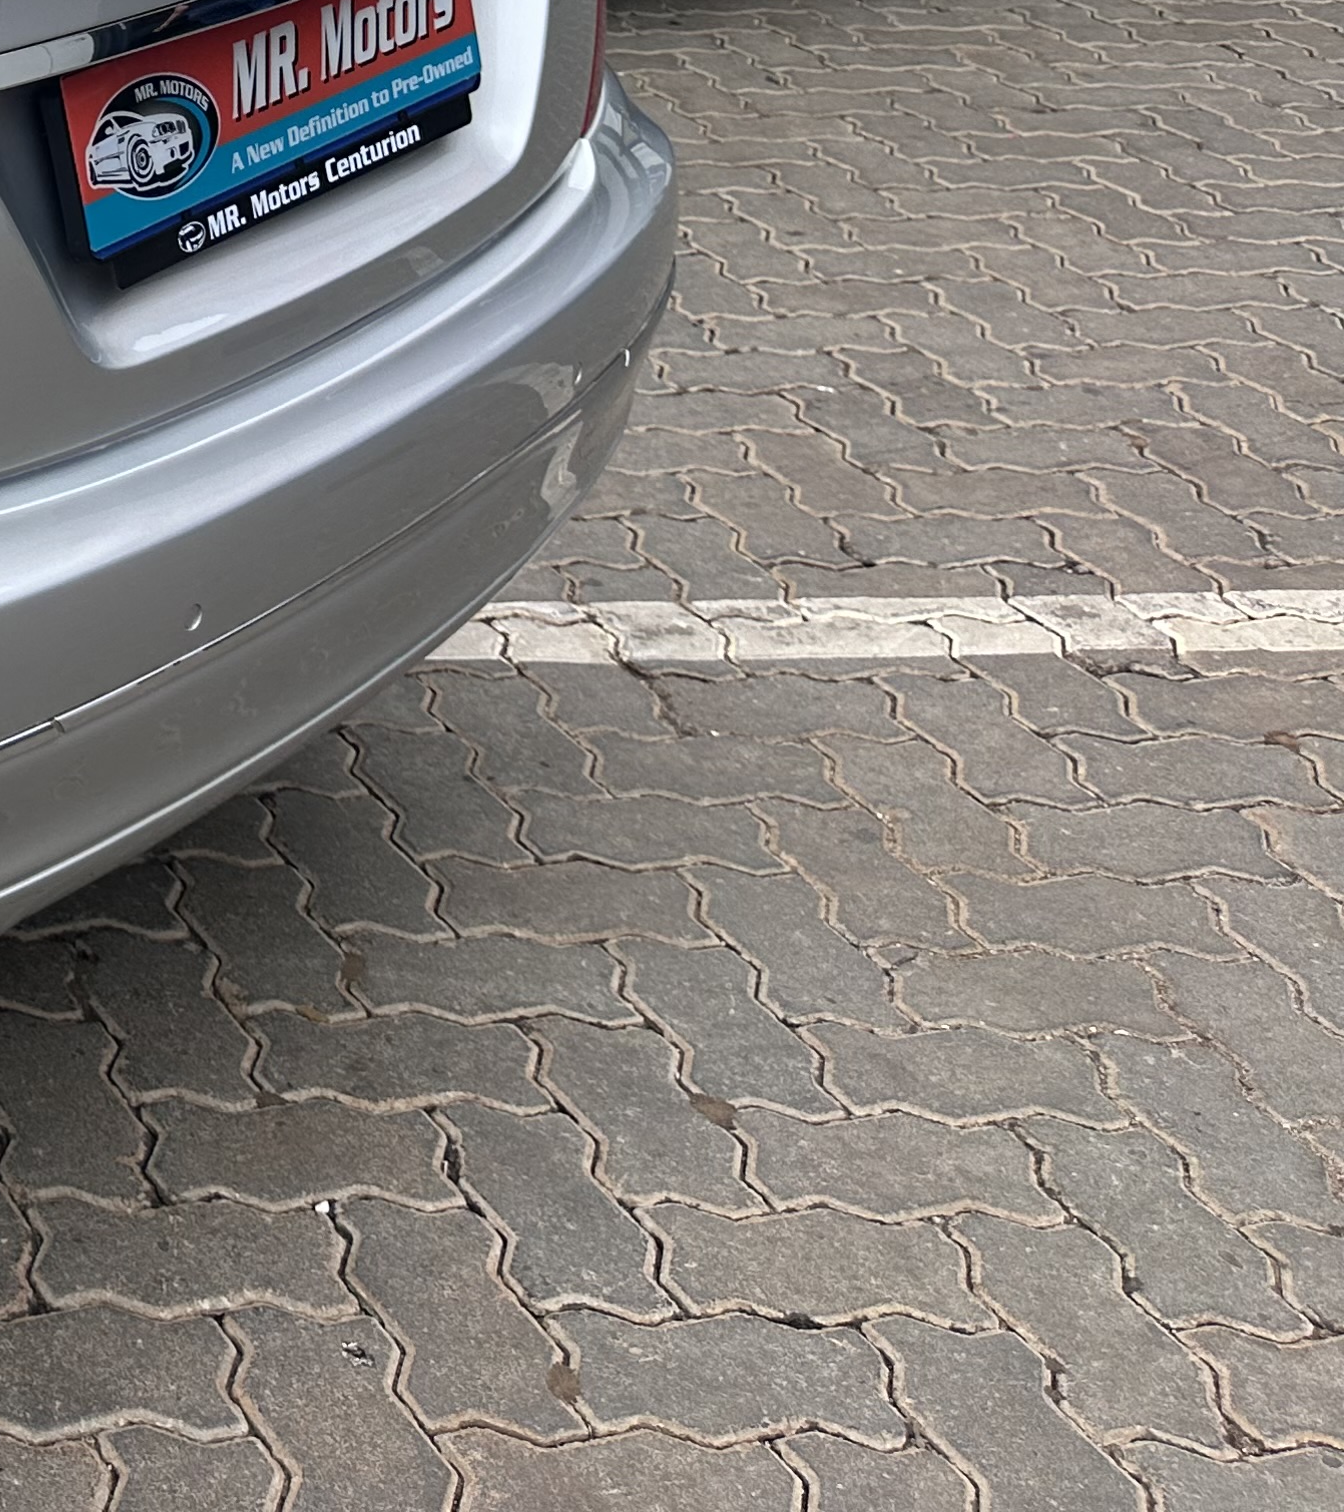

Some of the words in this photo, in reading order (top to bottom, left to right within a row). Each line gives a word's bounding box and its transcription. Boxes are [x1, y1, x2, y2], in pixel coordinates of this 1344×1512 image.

[134, 82, 159, 104] MR.
[159, 79, 210, 112] MOTORS
[230, 151, 245, 174] A
[246, 136, 285, 165] New
[286, 100, 371, 152] Definition
[370, 90, 390, 110] to
[391, 45, 475, 101] Pre-Owned
[231, 19, 312, 122] MR.
[207, 203, 248, 241] MR.
[250, 170, 321, 219] Motors
[324, 123, 422, 184] Centurion
